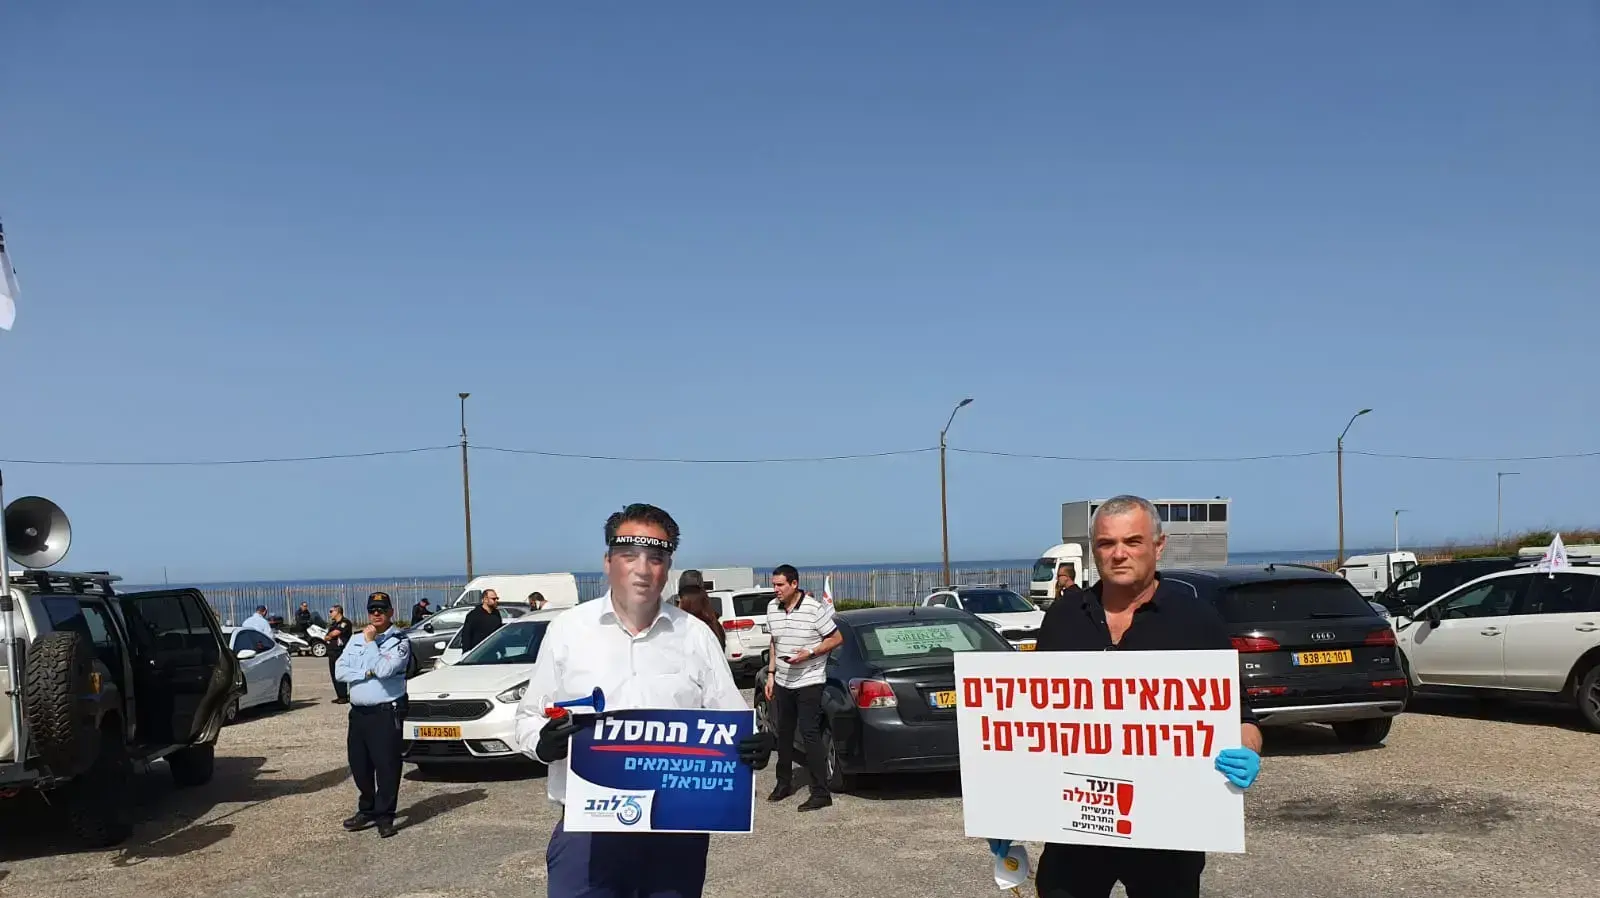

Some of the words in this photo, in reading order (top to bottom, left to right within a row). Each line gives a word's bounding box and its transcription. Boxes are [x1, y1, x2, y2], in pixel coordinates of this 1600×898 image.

[963, 677, 1094, 711] מפסיקים
[1102, 678, 1232, 711] עצמאים
[593, 716, 689, 743] תחסלו
[697, 719, 738, 745] אל
[981, 715, 1113, 756] שקופים!
[1121, 720, 1216, 757] להיות
[624, 757, 706, 773] העצמאים
[710, 760, 737, 774] את
[661, 773, 734, 791] בישראל!
[1086, 779, 1115, 794] ועד
[584, 795, 622, 811] להב
[1063, 787, 1114, 806] פעולה
[1080, 804, 1114, 815] תעשיית
[1080, 813, 1114, 823] התרבות
[1072, 820, 1114, 832] והאירועים
